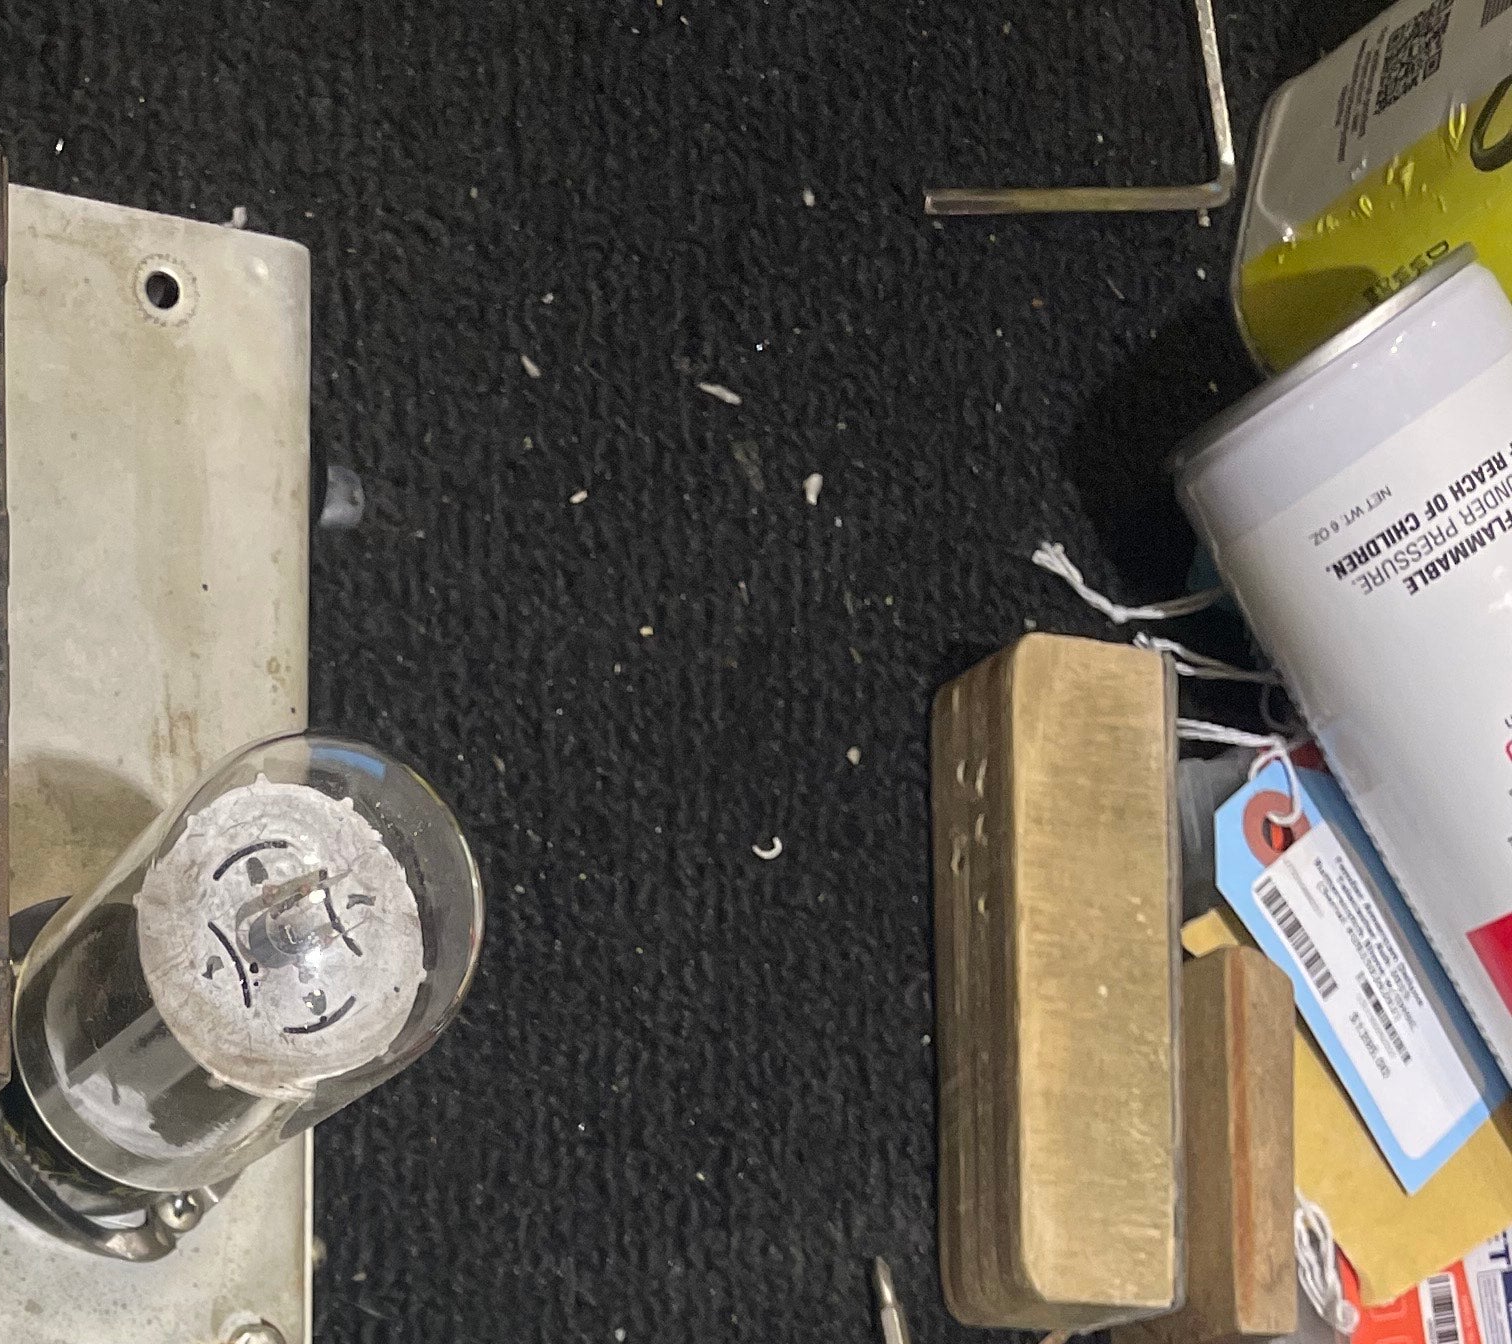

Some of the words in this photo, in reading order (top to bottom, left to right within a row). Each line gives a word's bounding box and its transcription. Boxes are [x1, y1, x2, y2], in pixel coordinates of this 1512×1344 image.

[1366, 485, 1393, 511] NET
[1448, 451, 1508, 503] REACH
[1424, 493, 1449, 521] OF
[1325, 512, 1421, 581] CHILDREN.
[1351, 517, 1459, 596] PRESSURE.
